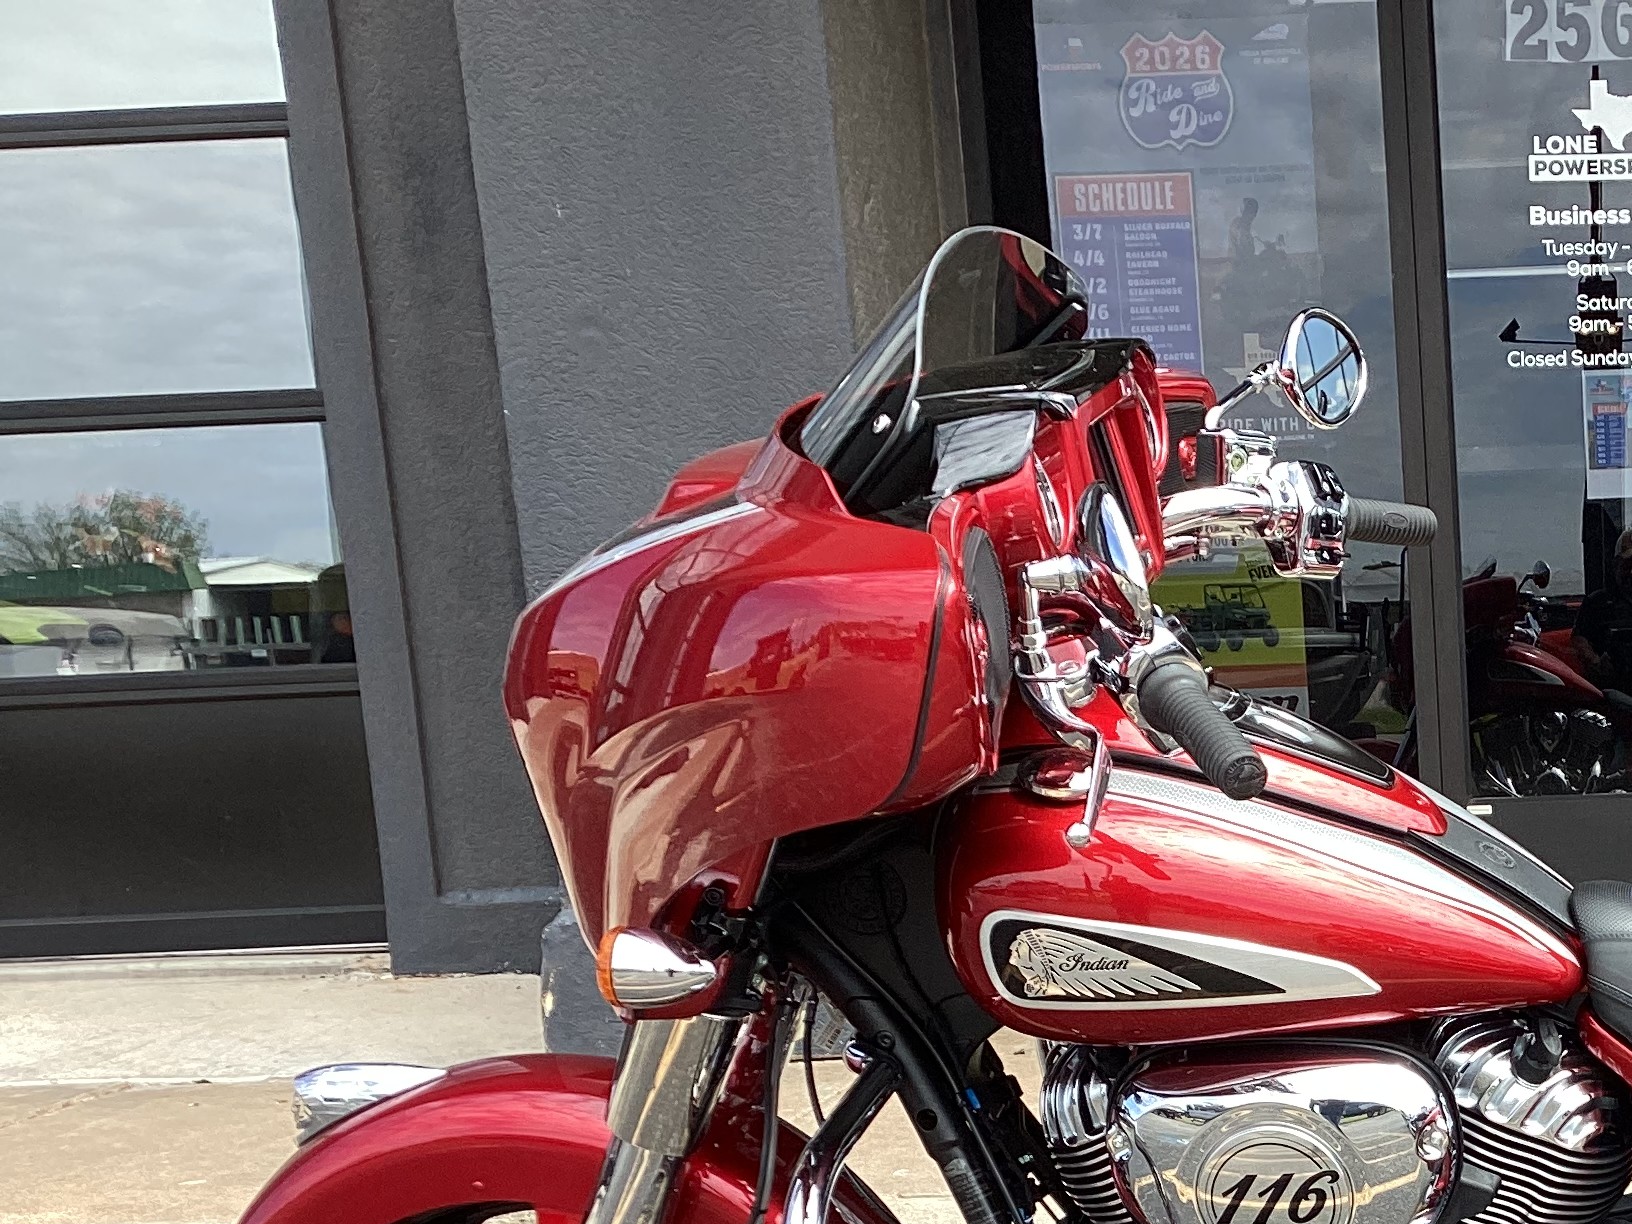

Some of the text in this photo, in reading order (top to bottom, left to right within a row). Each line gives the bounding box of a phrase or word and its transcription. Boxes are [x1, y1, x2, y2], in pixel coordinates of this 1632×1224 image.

[1134, 45, 1211, 71] 2026
[1128, 77, 1219, 117] Ride and
[1169, 103, 1223, 139] Dine
[1532, 134, 1598, 155] LONE
[1073, 181, 1175, 212] SCHEDULE
[1529, 205, 1631, 226] Business
[1074, 250, 1105, 267] 4/4
[1542, 239, 1618, 260] Tuesday
[1566, 261, 1609, 277] 9am
[1569, 316, 1610, 332] 9am
[1507, 350, 1568, 368] Closed
[1260, 417, 1299, 432] WITH
[1058, 953, 1129, 973] Indian
[1217, 1169, 1339, 1224] 116
